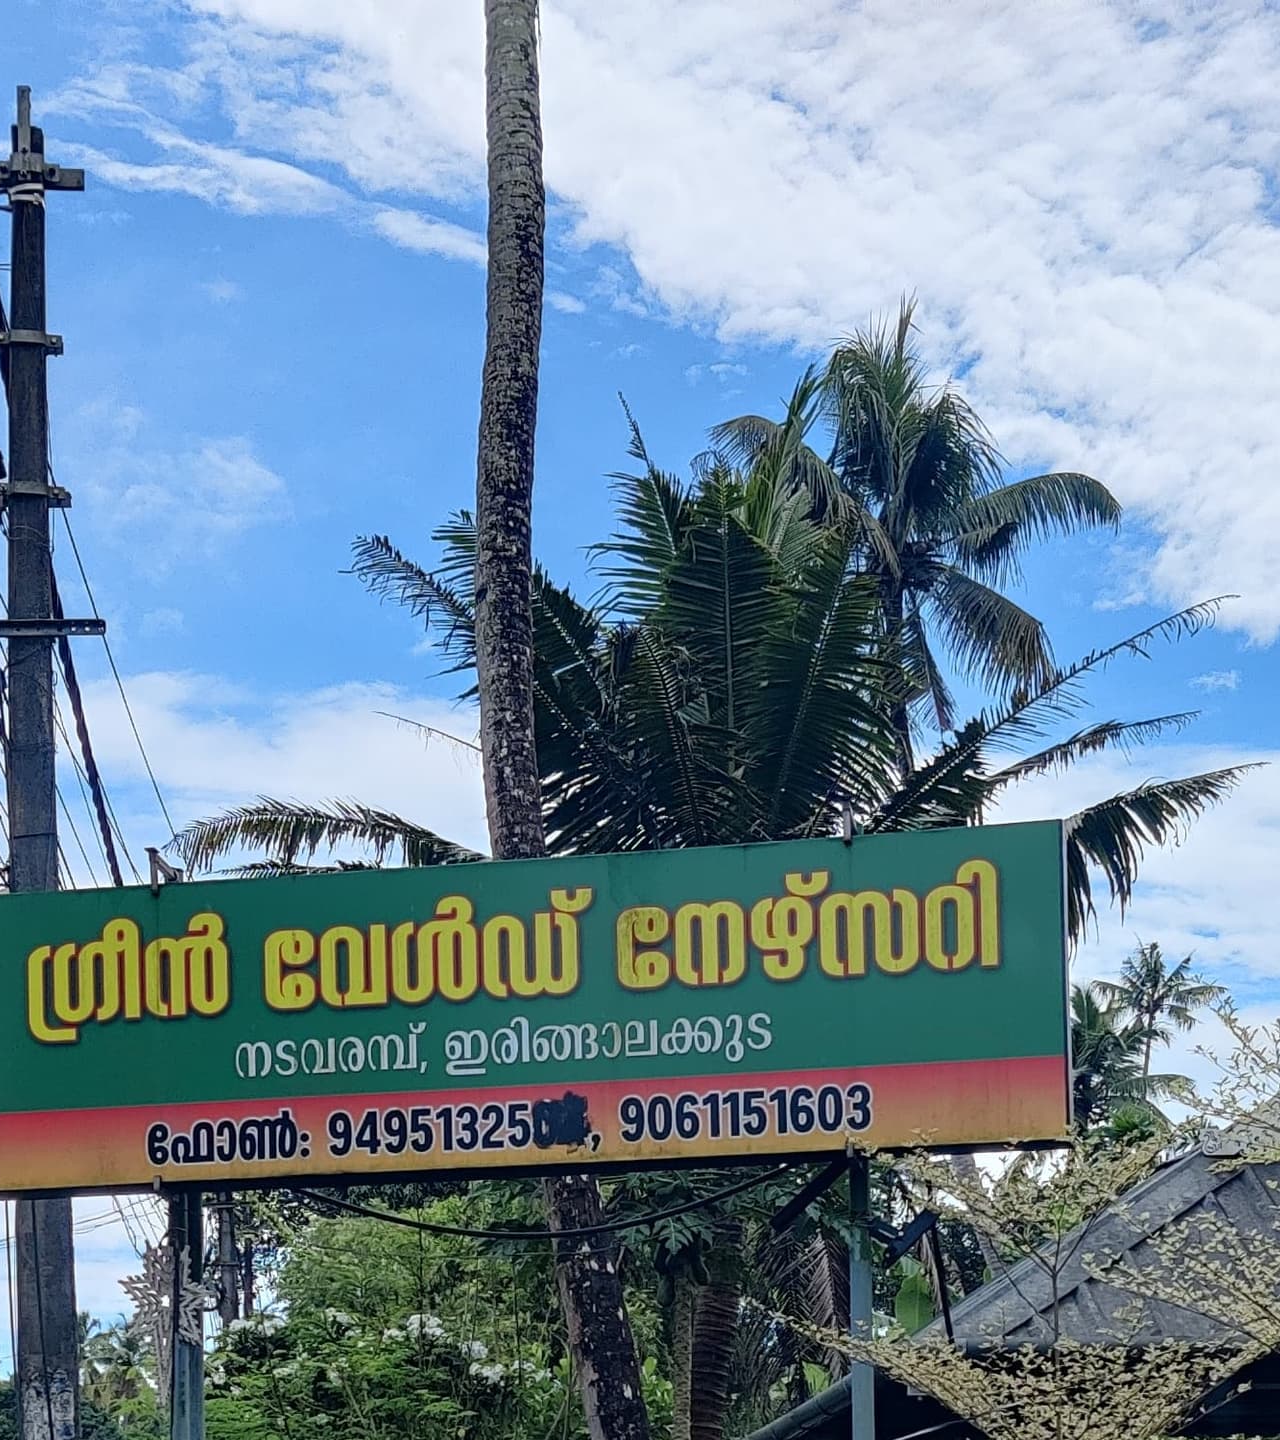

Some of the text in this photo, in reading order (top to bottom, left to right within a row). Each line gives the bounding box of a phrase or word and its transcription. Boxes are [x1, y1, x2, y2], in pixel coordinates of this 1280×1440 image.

[27, 858, 1000, 1042] ഗ്രീൻ വേൾഡ് നേഴ്സറി
[235, 1011, 773, 1079] നടവരമ്പ്, ഇരിങ്ങാലക്കുട
[146, 1081, 874, 1165] ഫോൺ: 94951325, 9061151603
